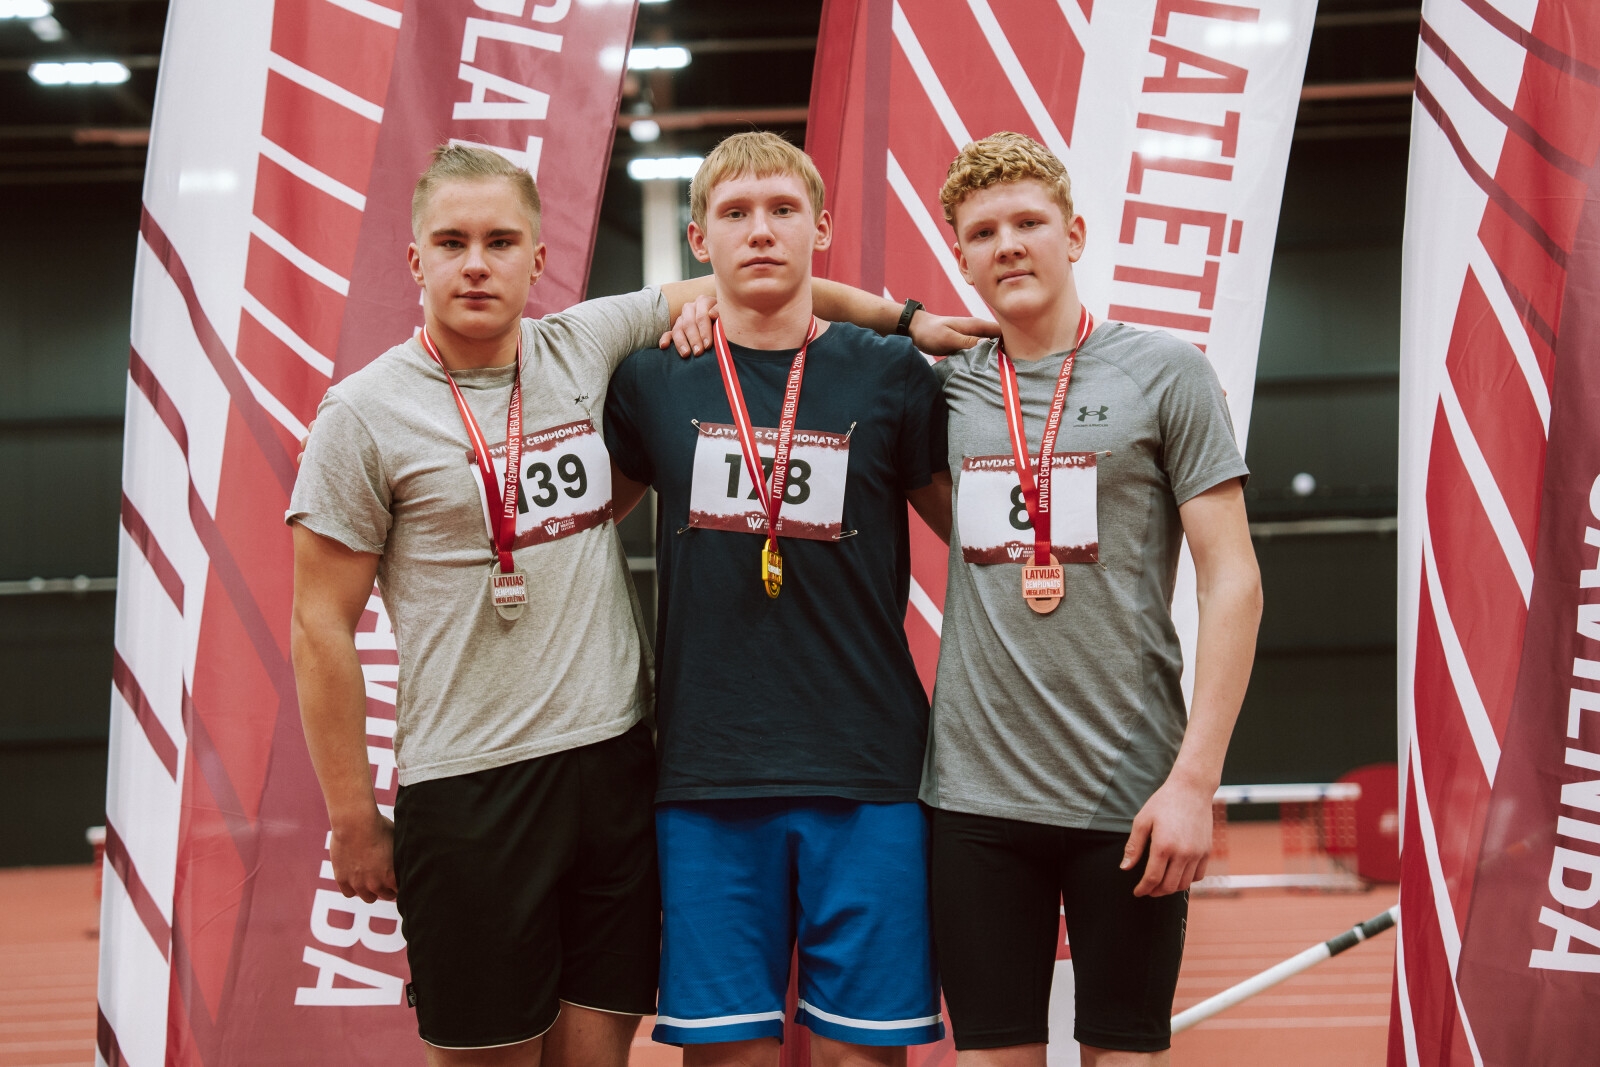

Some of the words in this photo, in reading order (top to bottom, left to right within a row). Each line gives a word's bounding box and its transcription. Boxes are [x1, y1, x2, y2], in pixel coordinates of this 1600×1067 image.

[1107, 0, 1260, 353] LATLĒTI
[793, 351, 804, 368] 2024
[1062, 357, 1073, 376] 2024
[783, 368, 801, 419] VIEGLATLĒTIKĀ
[1047, 376, 1069, 429] VIEGLATLĒTIKĀ
[707, 427, 763, 439] LATVS
[764, 430, 840, 446] ČEPIONATS
[775, 419, 793, 465] ČEMPIONĀTS
[1039, 429, 1056, 478] ČEMPIONĀTS
[505, 437, 520, 484] ČEMPIONĀTS
[724, 453, 812, 505] 178
[773, 465, 786, 499] LATVIJAS
[1039, 478, 1050, 513] LATVIJAS
[504, 484, 516, 519] LATVIJAS
[493, 575, 524, 588] LATVIJAS
[1025, 569, 1060, 580] LATVIJAS
